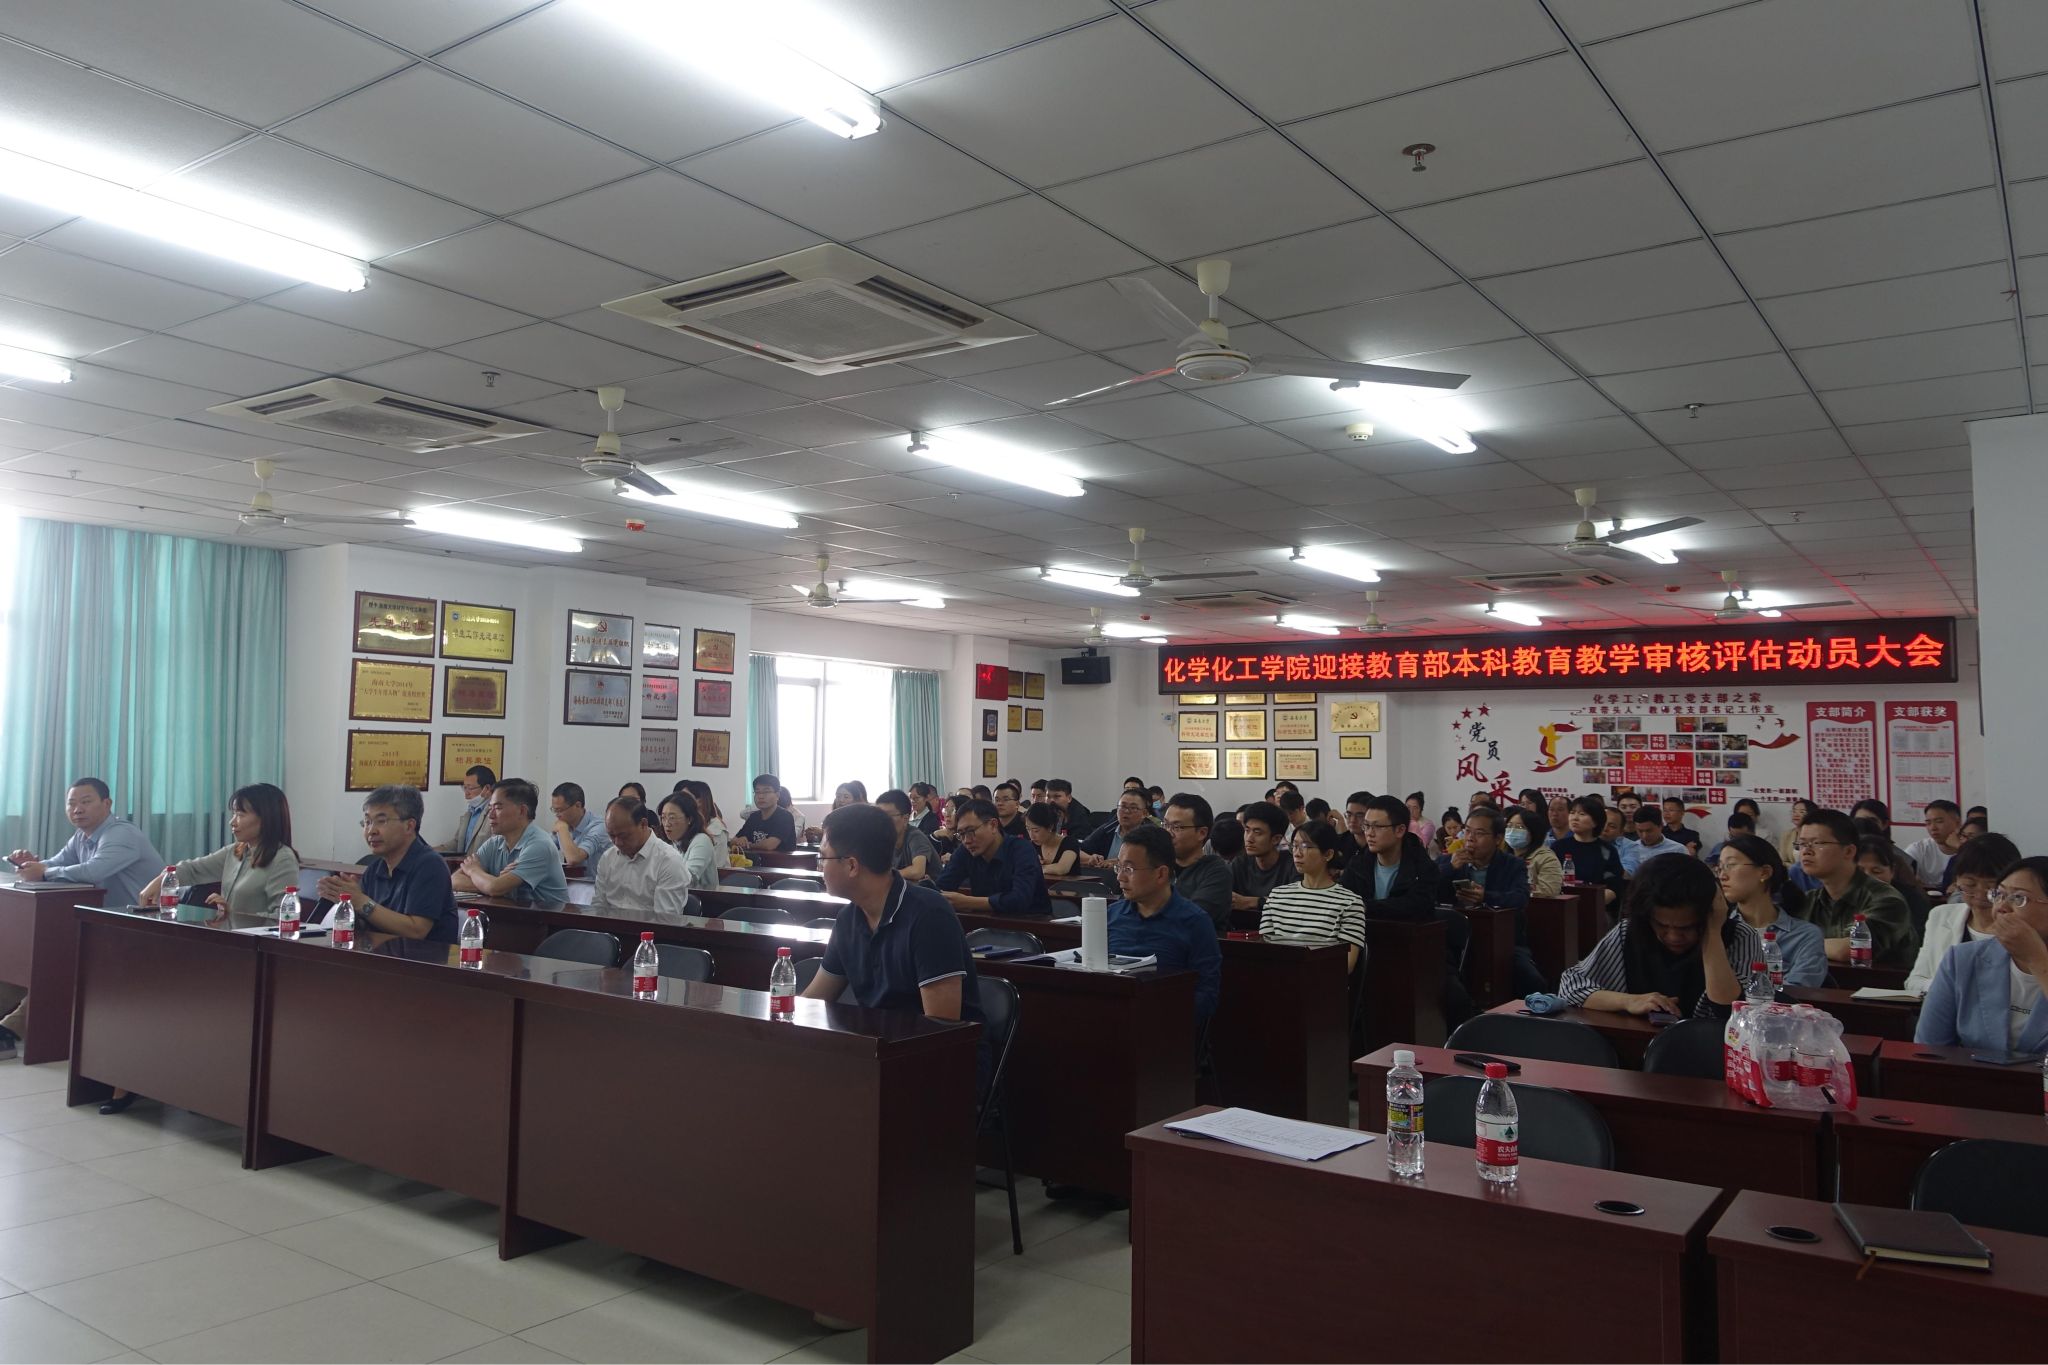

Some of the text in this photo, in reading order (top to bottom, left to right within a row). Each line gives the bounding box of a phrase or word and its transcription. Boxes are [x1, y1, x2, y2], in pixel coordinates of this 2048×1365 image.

[1164, 633, 1944, 683] 化学化工学院迎接教育部本科教育教学审核评估动员大会
[1815, 707, 1867, 718] 支部简介
[1893, 706, 1947, 718] 支部获奖
[1643, 753, 1676, 762] 入党誓词
